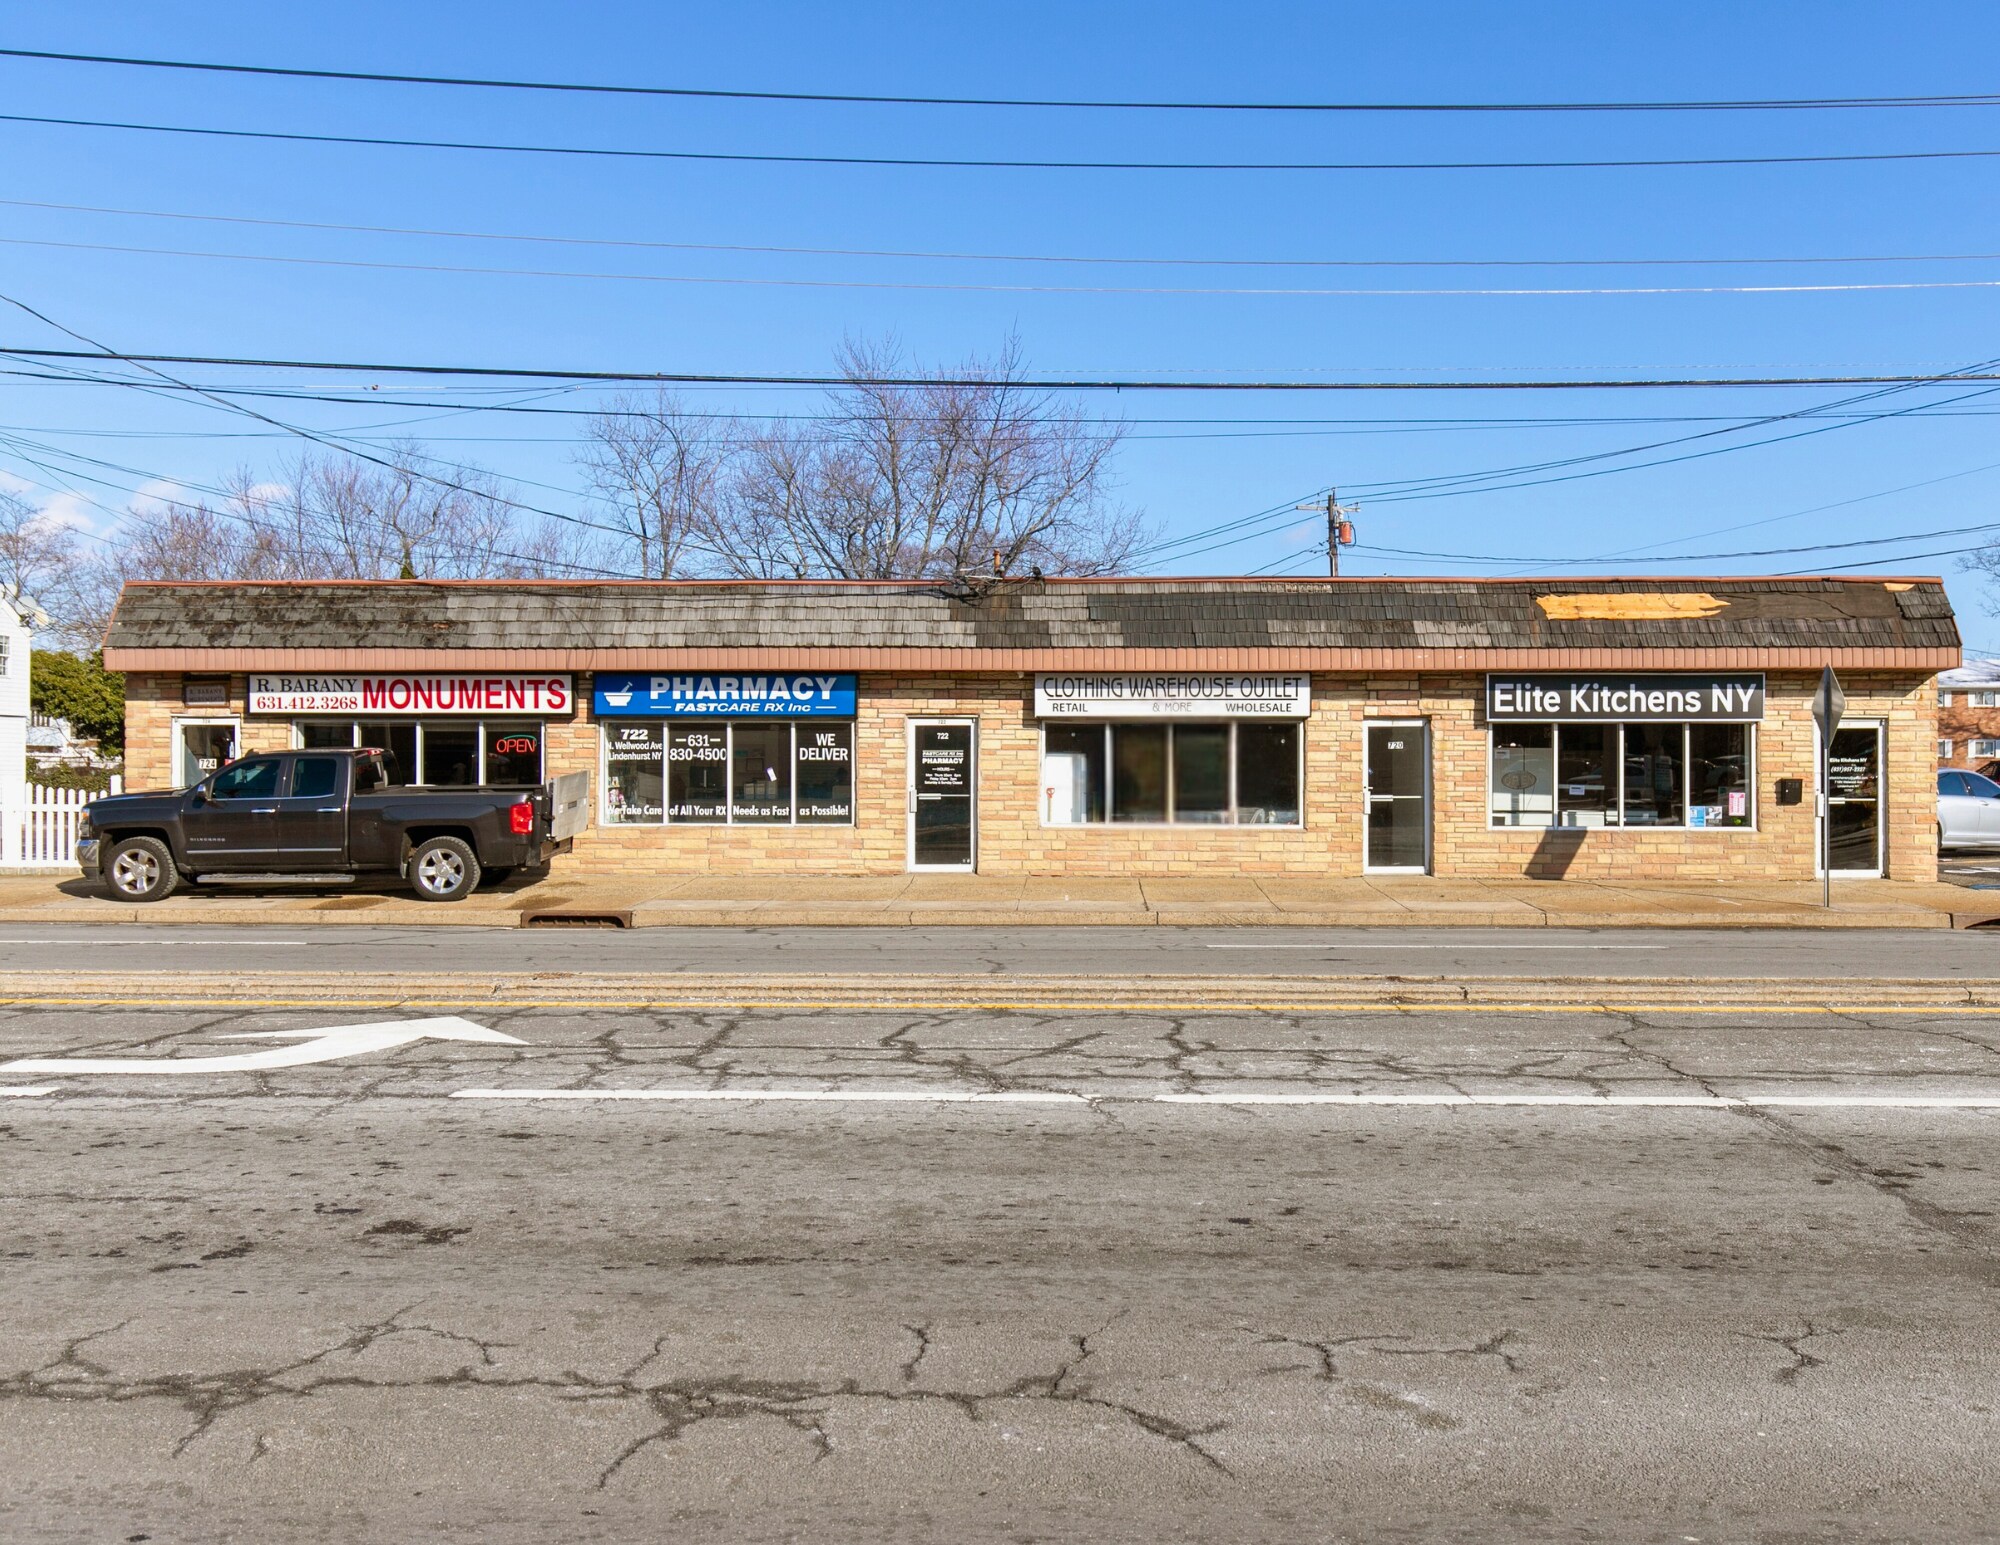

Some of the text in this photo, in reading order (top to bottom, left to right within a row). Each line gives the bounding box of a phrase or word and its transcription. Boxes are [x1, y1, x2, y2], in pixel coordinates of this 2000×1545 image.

[256, 678, 358, 693] R. BARANY
[650, 677, 837, 700] PHARMACY
[1043, 677, 1302, 697] CLOTHING WAREHOUSE OUTLET
[362, 679, 566, 710] MONUMENTS
[1494, 683, 1757, 713] Elite Kitchens NY
[257, 696, 358, 710] 631.412.3268
[675, 703, 811, 712] FASTCARE RX Inc
[1052, 702, 1088, 713] RETAIL
[1152, 702, 1192, 712] & MORE
[1225, 702, 1292, 713] WHOLESALE
[620, 729, 649, 740] 722
[815, 733, 836, 746] WE
[936, 732, 949, 740] 722
[496, 738, 536, 753] OPEN
[615, 742, 649, 750] Wellwood
[650, 742, 662, 750] Ave
[608, 752, 662, 761] Lindenhurst NY
[669, 748, 727, 761] 830-4500
[799, 748, 849, 761] DELIVER
[200, 760, 215, 768] 724
[922, 757, 964, 765] PHARMACY
[622, 805, 643, 815] Take
[644, 805, 662, 815] Care
[669, 804, 727, 815] of All Your RX
[733, 805, 789, 815] Needs as Fast
[799, 805, 849, 815] as Possible!
